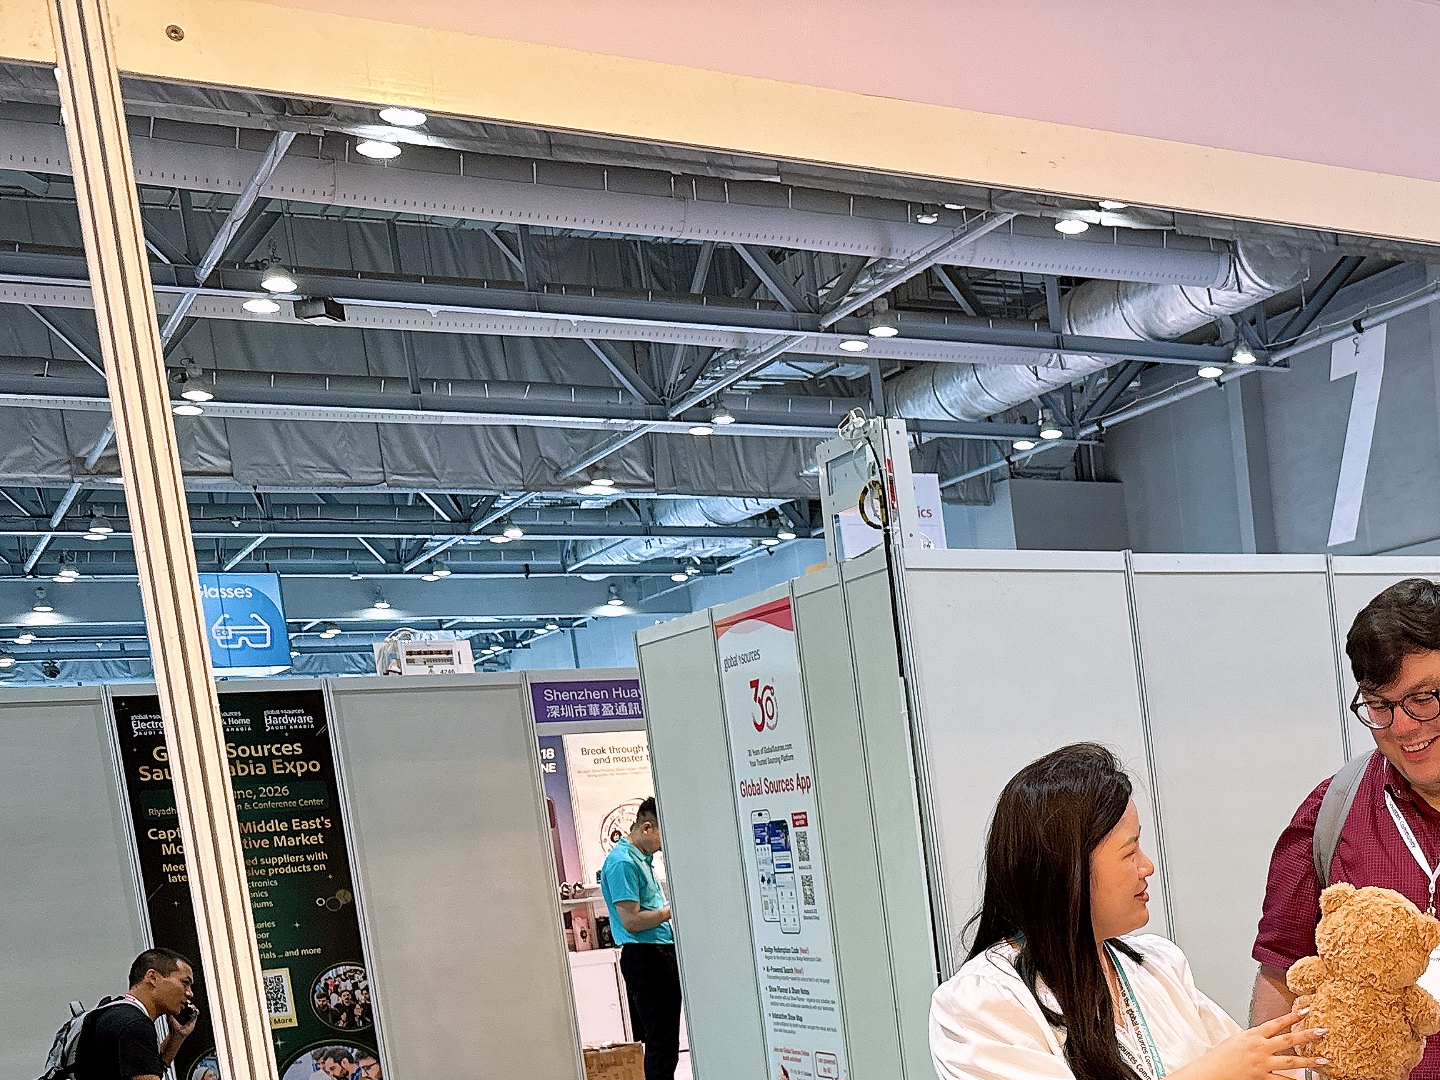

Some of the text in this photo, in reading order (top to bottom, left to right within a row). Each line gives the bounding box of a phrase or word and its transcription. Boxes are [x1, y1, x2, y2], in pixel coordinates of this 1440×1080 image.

[917, 505, 933, 518] ics
[199, 584, 253, 599] lasses
[543, 687, 609, 702] Shenzhen
[546, 702, 643, 719] 深圳市華盈通訊
[131, 719, 164, 730] Electro
[264, 714, 314, 727] Hardware
[226, 742, 303, 759] Sources
[581, 744, 644, 757] Break through
[593, 755, 643, 765] and master
[138, 759, 321, 782] Sau abia Expo
[258, 786, 290, 799] 2026
[740, 772, 812, 798] Global Sources App
[252, 800, 297, 811] Conference
[298, 798, 324, 807] Center
[147, 816, 332, 842] Capt Middle East's
[242, 832, 324, 849] tive Market
[260, 851, 328, 866] suppliers with
[268, 863, 326, 877] products on
[248, 878, 278, 888] tronics
